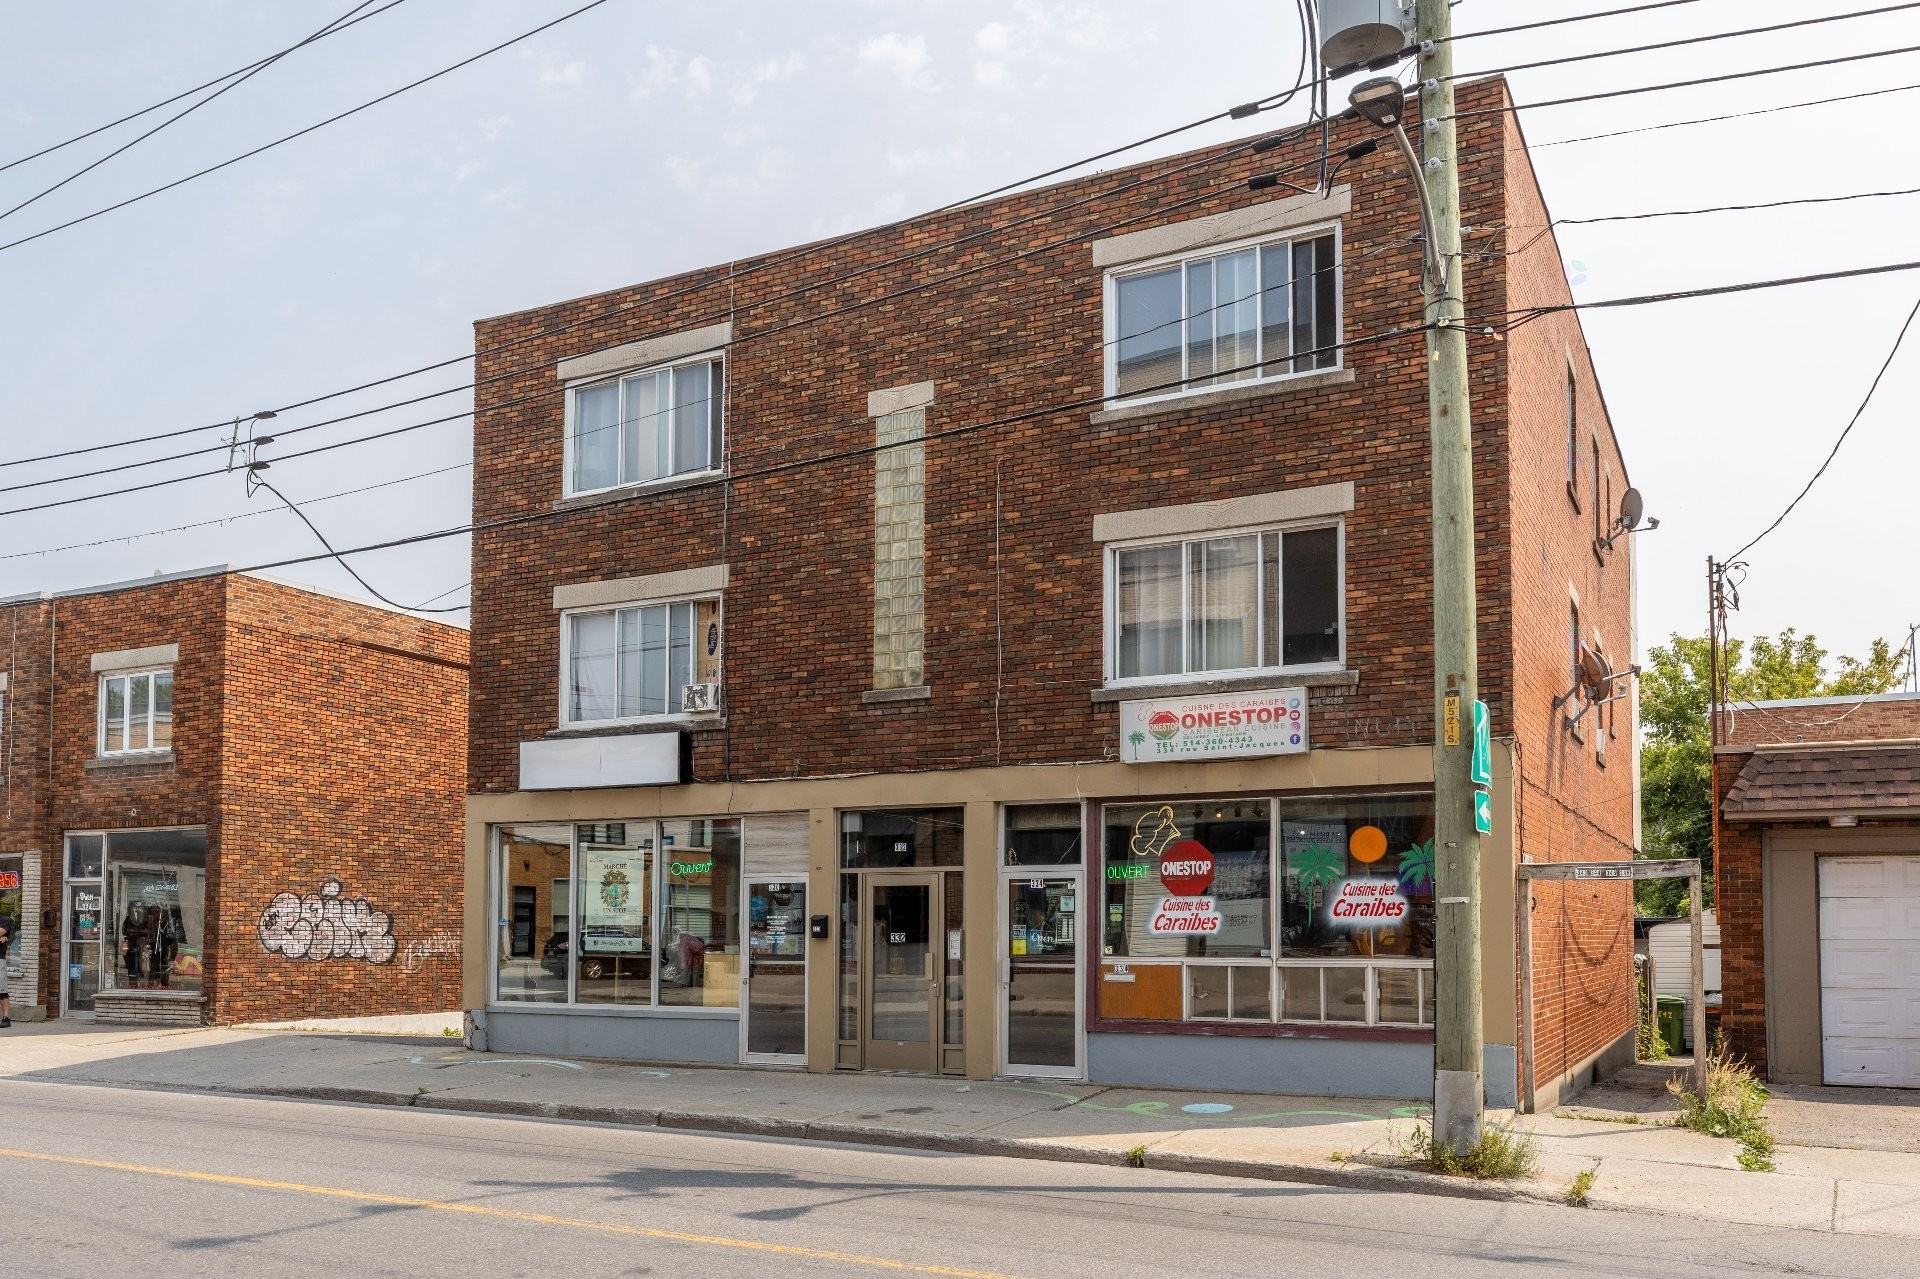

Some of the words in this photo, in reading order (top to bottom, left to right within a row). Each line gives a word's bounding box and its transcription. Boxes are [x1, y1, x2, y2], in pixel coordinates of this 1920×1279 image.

[1219, 701, 1237, 709] DES
[1181, 707, 1287, 729] ONESTOP
[1150, 723, 1179, 731] ONESTOP
[1183, 727, 1239, 735] CARIBBEAN
[1244, 723, 1286, 731] CUISINE
[1183, 736, 1253, 746] 514-360-4343
[671, 860, 712, 876] Ouvert
[1107, 865, 1149, 878] OUVERT
[1161, 860, 1211, 876] ONESTOP
[1342, 882, 1376, 896] Cuisine
[1378, 882, 1396, 896] des
[1162, 899, 1193, 911] Cuisine
[1194, 899, 1210, 911] des
[1333, 897, 1405, 917] Caraibes
[1154, 913, 1218, 930] Caraibes
[891, 932, 906, 942] 332
